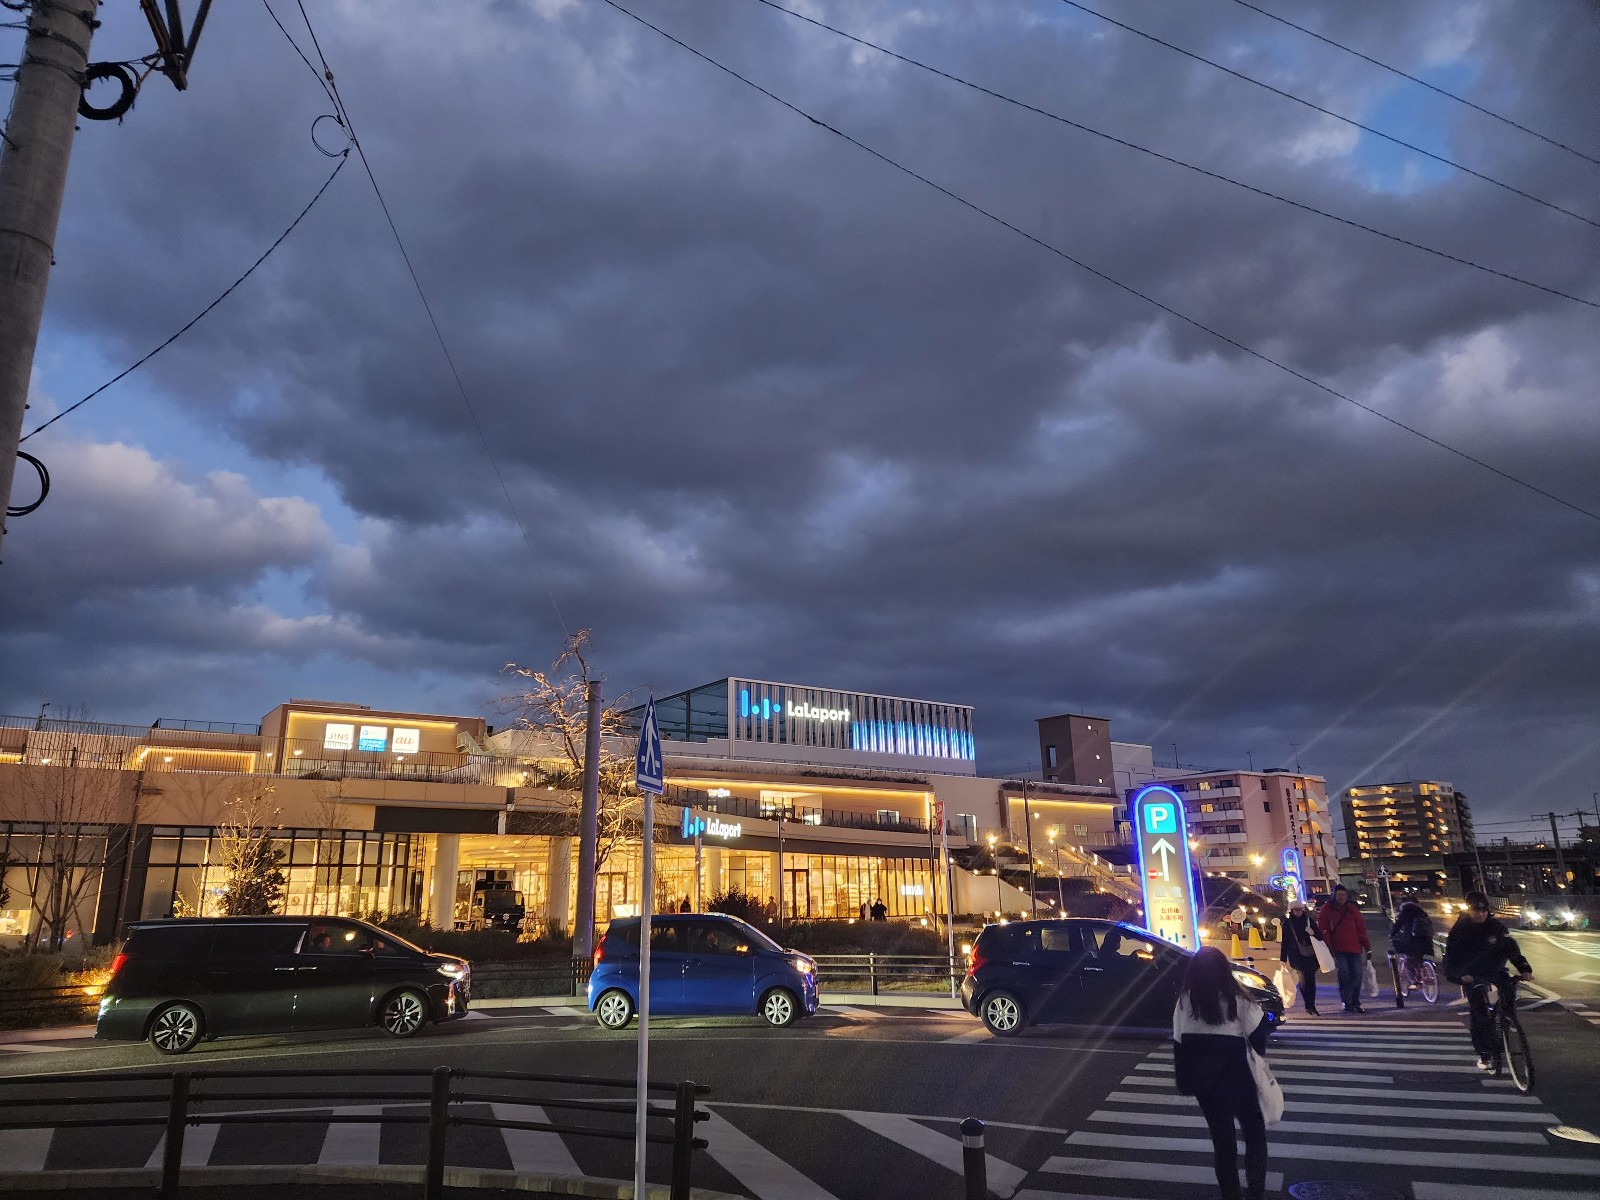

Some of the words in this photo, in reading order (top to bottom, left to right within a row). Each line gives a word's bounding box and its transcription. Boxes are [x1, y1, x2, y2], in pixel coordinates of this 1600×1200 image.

[787, 700, 851, 722] LaLaport
[395, 737, 415, 745] au
[706, 817, 742, 840] LaLaport
[1150, 806, 1169, 830] P
